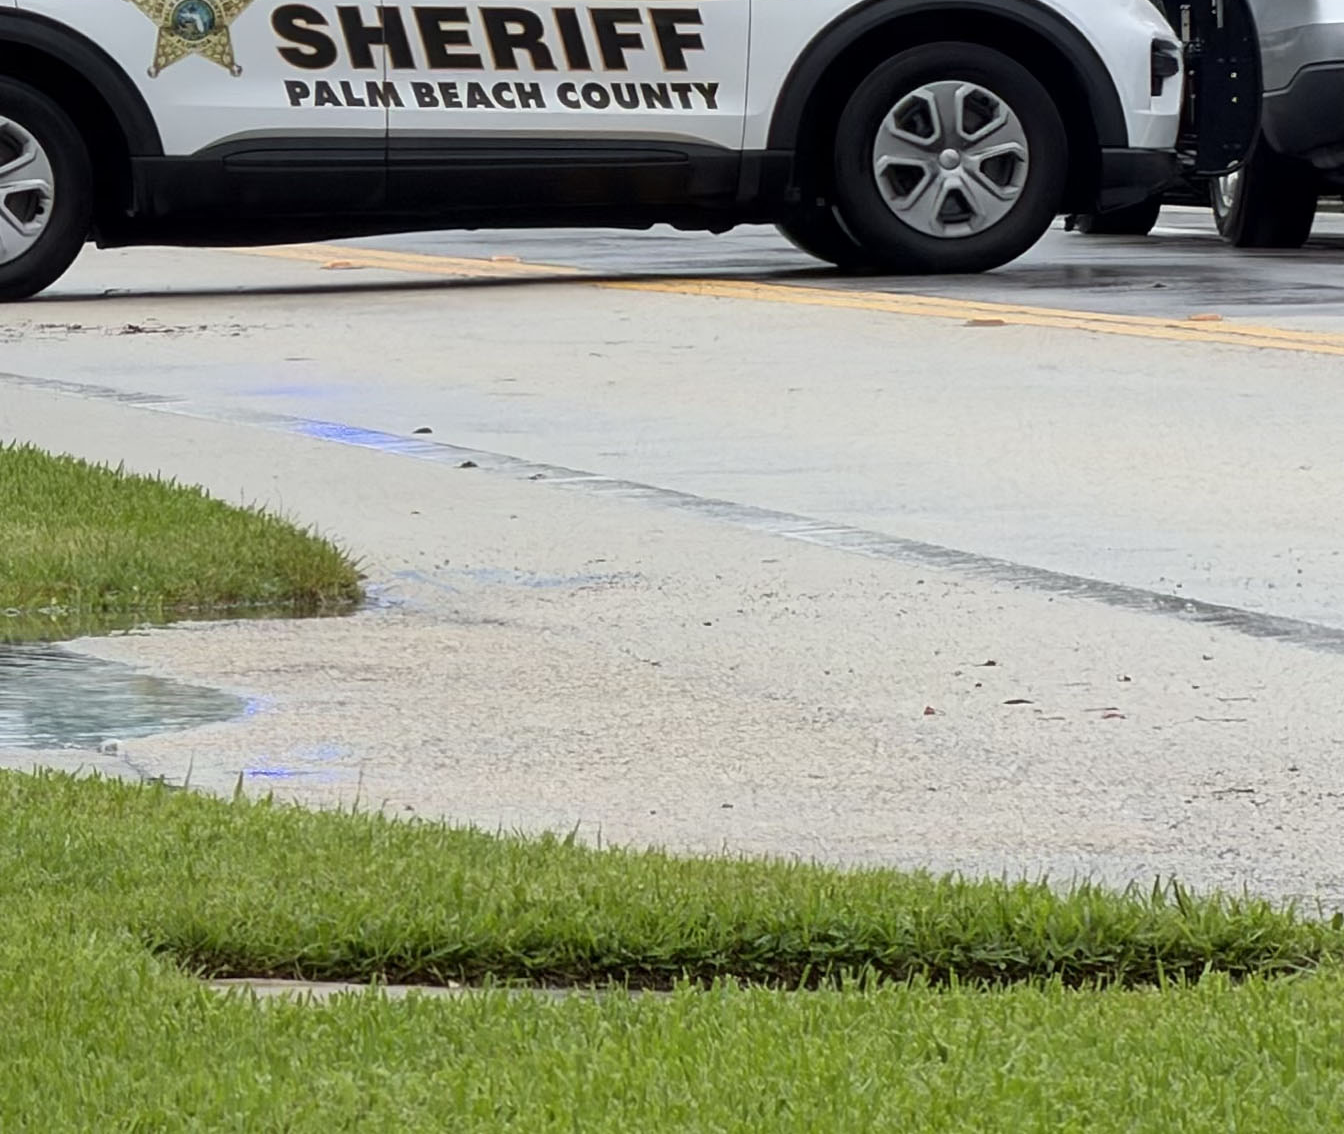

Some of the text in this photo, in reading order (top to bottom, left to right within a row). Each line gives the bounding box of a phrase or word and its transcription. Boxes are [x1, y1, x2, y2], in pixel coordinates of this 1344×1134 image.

[271, 4, 704, 71] SHERIFF
[284, 80, 719, 110] PALM BEACH COUNTY
